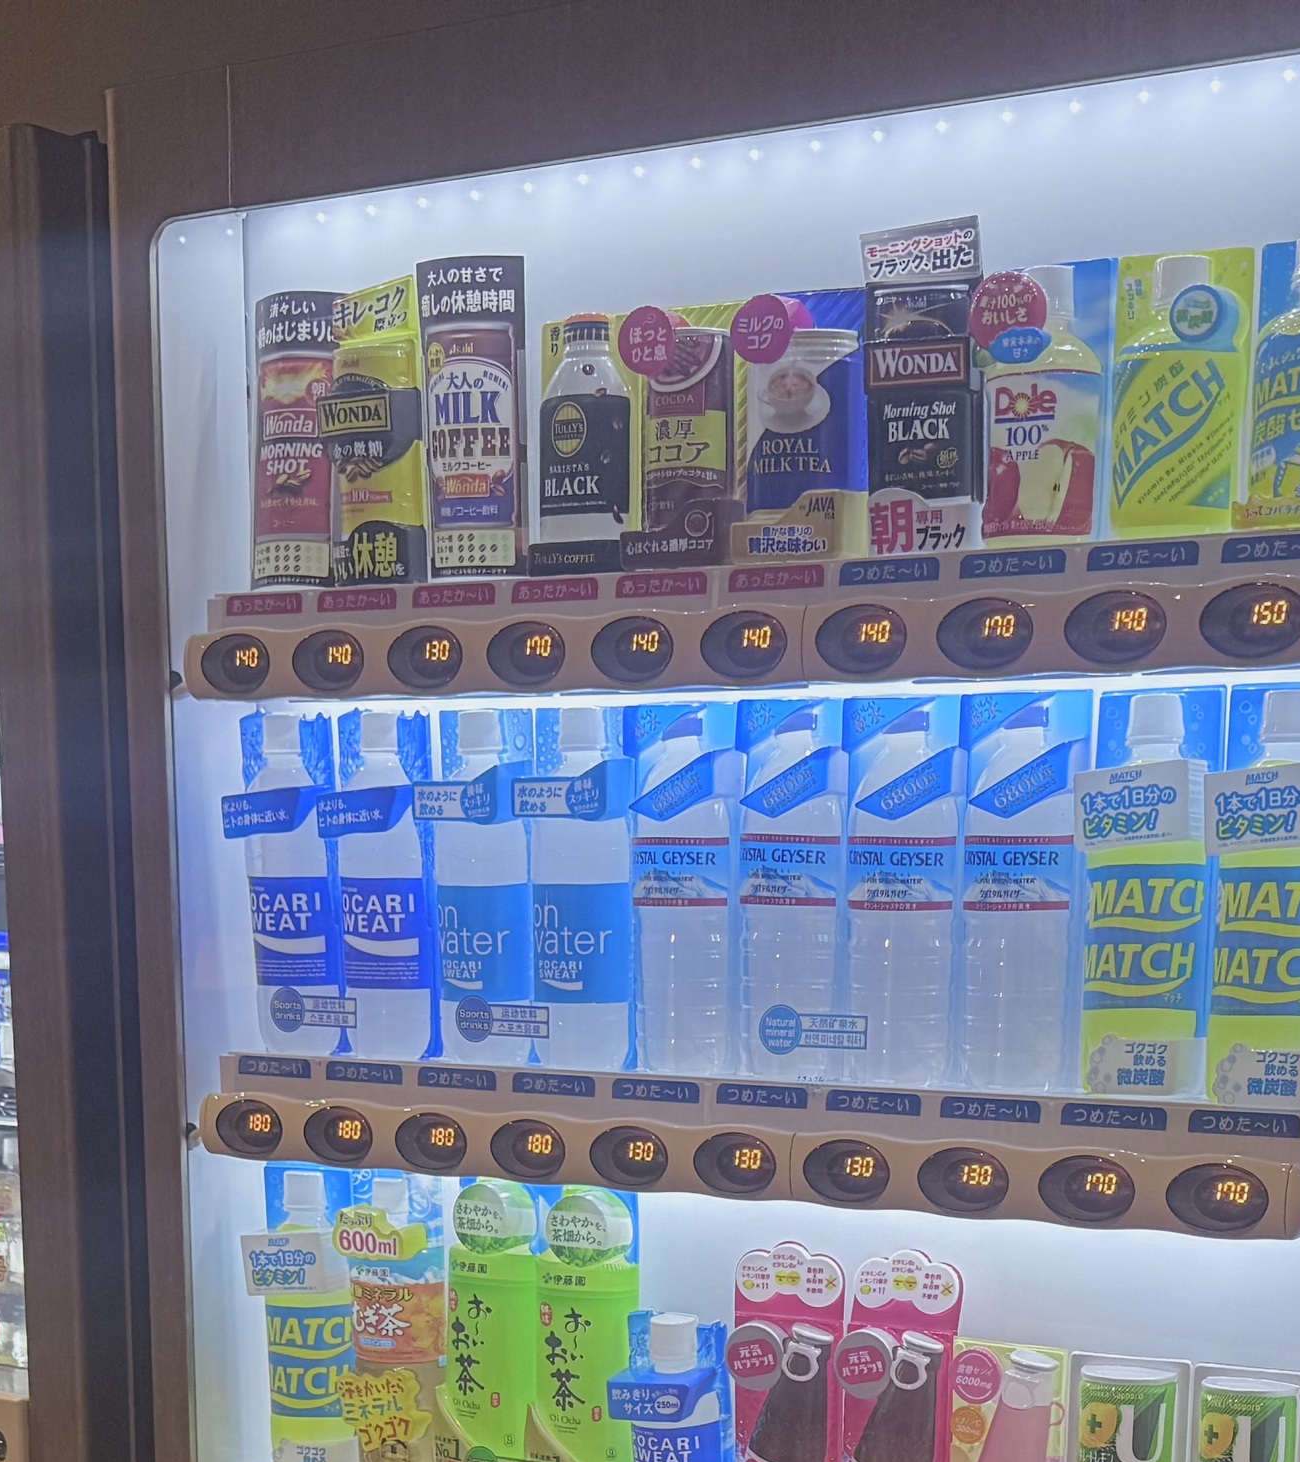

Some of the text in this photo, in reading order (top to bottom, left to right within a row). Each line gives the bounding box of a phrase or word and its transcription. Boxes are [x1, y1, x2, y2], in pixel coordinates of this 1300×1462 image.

[866, 228, 974, 259] モーニングショットの
[427, 267, 503, 288] 大人の甘さで
[421, 289, 515, 318] 癒しの休憩時間
[737, 315, 784, 334] ミルクの
[981, 306, 1028, 325] おいしさ
[629, 327, 667, 344] ほっと
[747, 334, 772, 350] コク
[631, 344, 668, 363] ひと息
[874, 348, 958, 379] WONDA
[434, 391, 502, 426] MILK
[655, 393, 695, 408] COCOA
[994, 382, 1058, 418] Dole
[321, 401, 382, 427] WONDA
[883, 401, 957, 421] Morning Shot
[266, 411, 314, 436] Wonda
[655, 419, 695, 441] 濃厚
[888, 417, 950, 443] BLACK
[1111, 358, 1227, 495] MATCH
[432, 427, 511, 462] COFFEE
[1006, 424, 1050, 446] 100%
[261, 443, 323, 460] MORNING
[650, 442, 710, 464] ココア
[762, 438, 818, 455] ROYAL
[1005, 449, 1041, 462] APPLE
[267, 460, 308, 475] SHOT
[753, 456, 832, 474] MILK TEA
[446, 476, 488, 494] Wonda
[544, 475, 599, 498] BLACK
[916, 509, 943, 524] 専用
[761, 525, 812, 537] 豊かな香りの
[869, 499, 914, 556] 朝
[917, 523, 966, 551] ブラック
[747, 537, 827, 555] 贅沢な味わい
[1254, 601, 1288, 625] 150
[985, 616, 1015, 637] 170
[527, 636, 552, 657] 170
[745, 627, 772, 648] 140
[237, 648, 258, 667] 140
[427, 641, 450, 661] 130
[517, 786, 562, 801] 水のように
[1081, 786, 1175, 816] 1本で1日分の
[518, 799, 546, 813] 飲める
[849, 850, 945, 867] CRYSTAL GEYSER
[1005, 850, 1059, 867] GEYSER
[539, 960, 583, 971] POCARI
[539, 970, 578, 980] SWEAT
[459, 1008, 490, 1021] Sports
[766, 1016, 796, 1029] Natural
[809, 1017, 858, 1030] 天然矿泉水
[460, 1019, 490, 1032] drinks
[766, 1027, 796, 1038] mineral
[768, 1038, 793, 1050] water
[1117, 1068, 1166, 1087] 微炭酸
[1247, 1078, 1297, 1097] 微炭酸
[249, 1114, 271, 1132] 180
[431, 1128, 455, 1147] 180
[629, 1142, 654, 1161] 130
[848, 1157, 874, 1177] 130
[1087, 1173, 1117, 1195] 170
[1217, 1181, 1249, 1204] 170
[339, 1230, 397, 1256] 600ml
[612, 1389, 650, 1401] 飲みきり
[623, 1403, 653, 1415] サイズ
